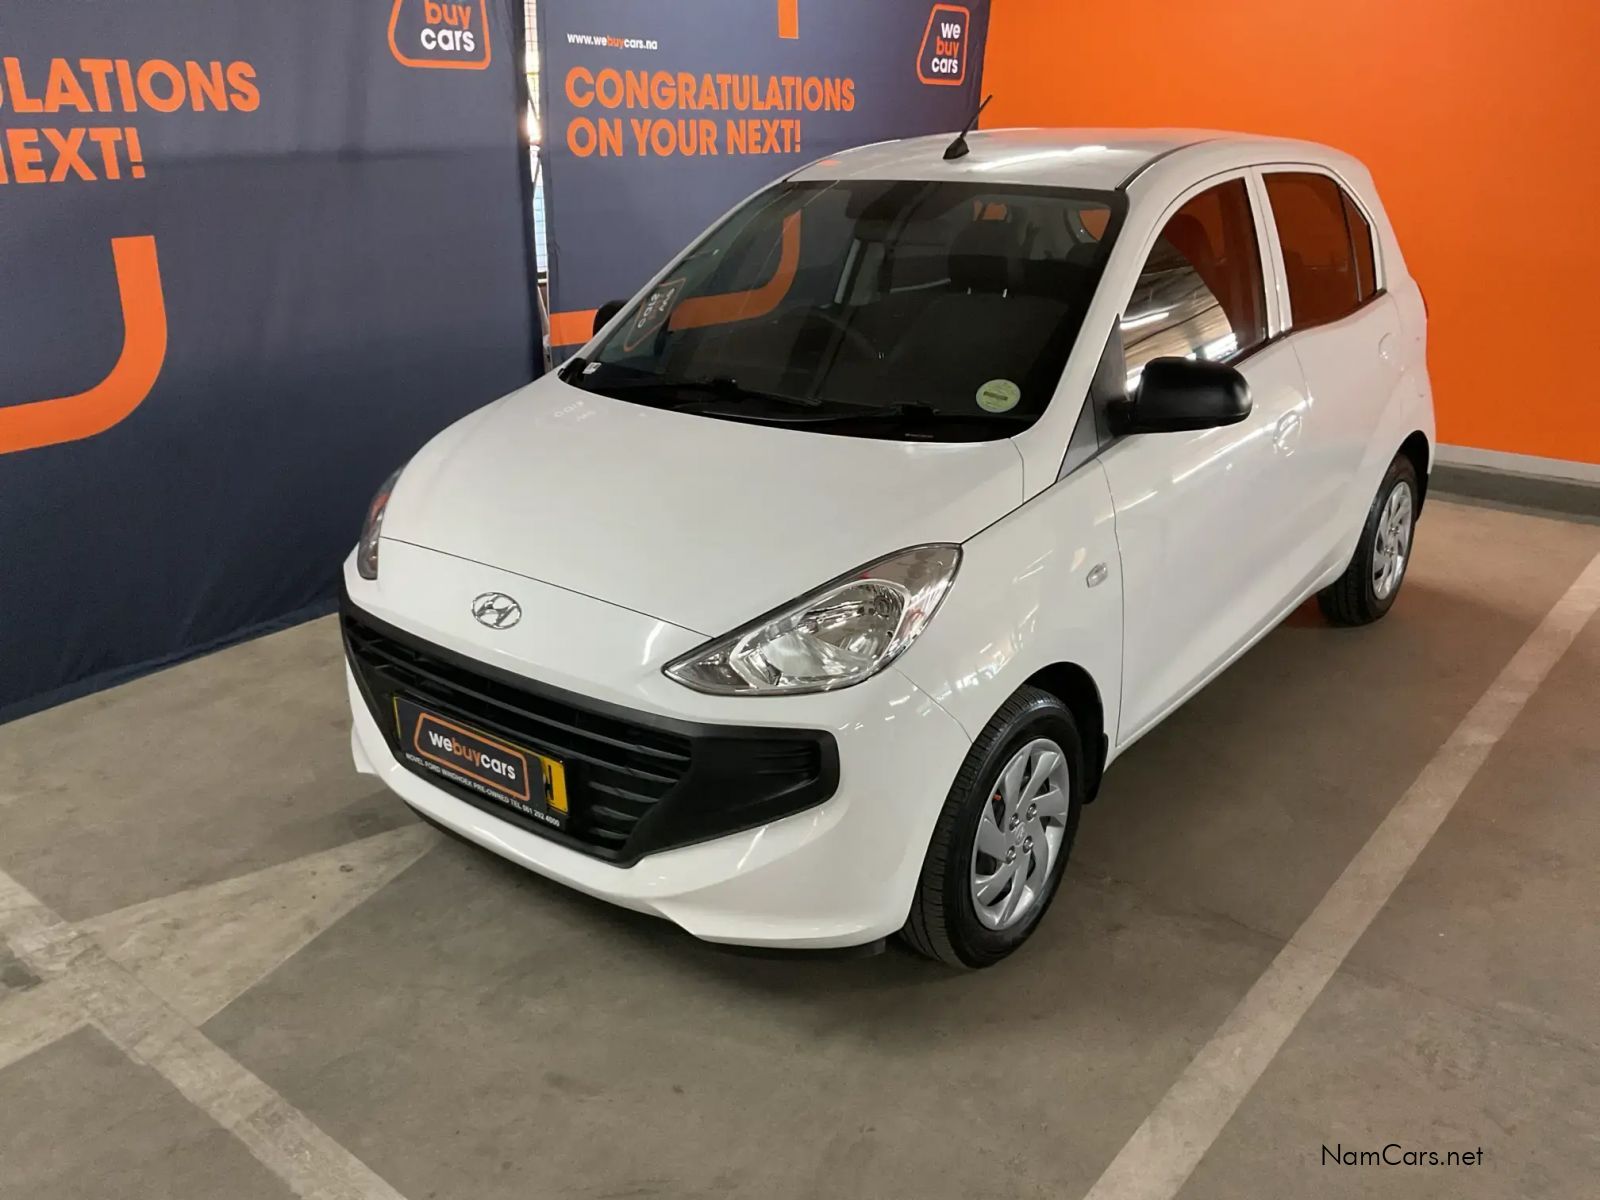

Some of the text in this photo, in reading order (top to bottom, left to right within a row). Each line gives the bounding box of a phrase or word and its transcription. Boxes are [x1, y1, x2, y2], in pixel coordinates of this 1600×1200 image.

[424, 0, 472, 29] buy
[420, 28, 476, 52] cars
[566, 33, 658, 50] www.webuycars.na
[941, 22, 961, 39] we
[936, 35, 959, 58] buy
[931, 57, 959, 74] cars
[0, 57, 260, 112] LATIONS
[565, 66, 856, 112] CONGRATULATIONS
[566, 118, 800, 157] ON YOUR NEXT!
[0, 127, 146, 184] EXT!
[428, 729, 516, 780] webuycars
